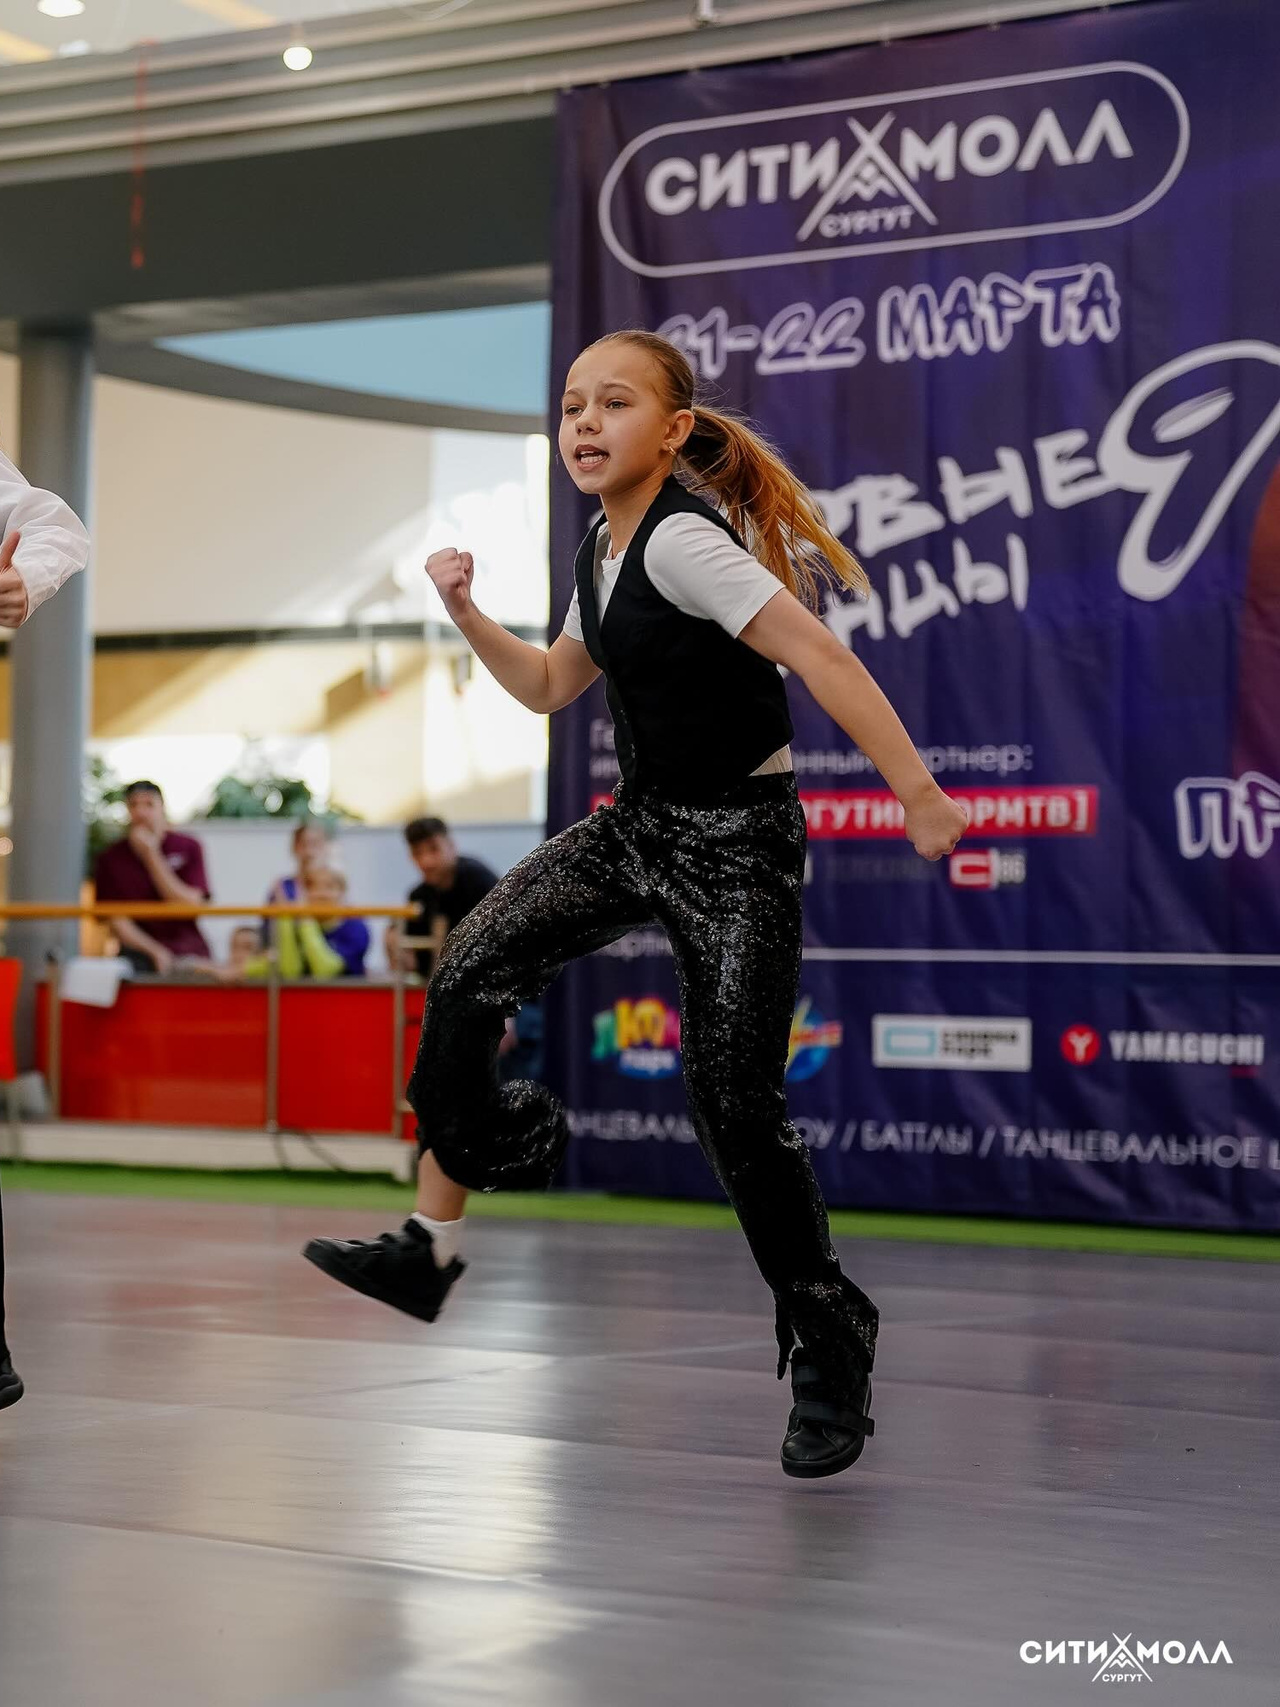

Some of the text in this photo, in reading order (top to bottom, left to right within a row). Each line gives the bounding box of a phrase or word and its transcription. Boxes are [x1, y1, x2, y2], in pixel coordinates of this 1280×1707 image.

[645, 99, 1133, 215] СИТИ МОЛЛ
[820, 205, 914, 238] СУРГУТ
[877, 262, 1120, 363] МАРТА
[1109, 1030, 1264, 1065] YAMAGUCHI
[861, 1119, 972, 1156] БАТТЛЫ
[1001, 1125, 1261, 1169] ТАНЦЕВАЛЬНОЕ
